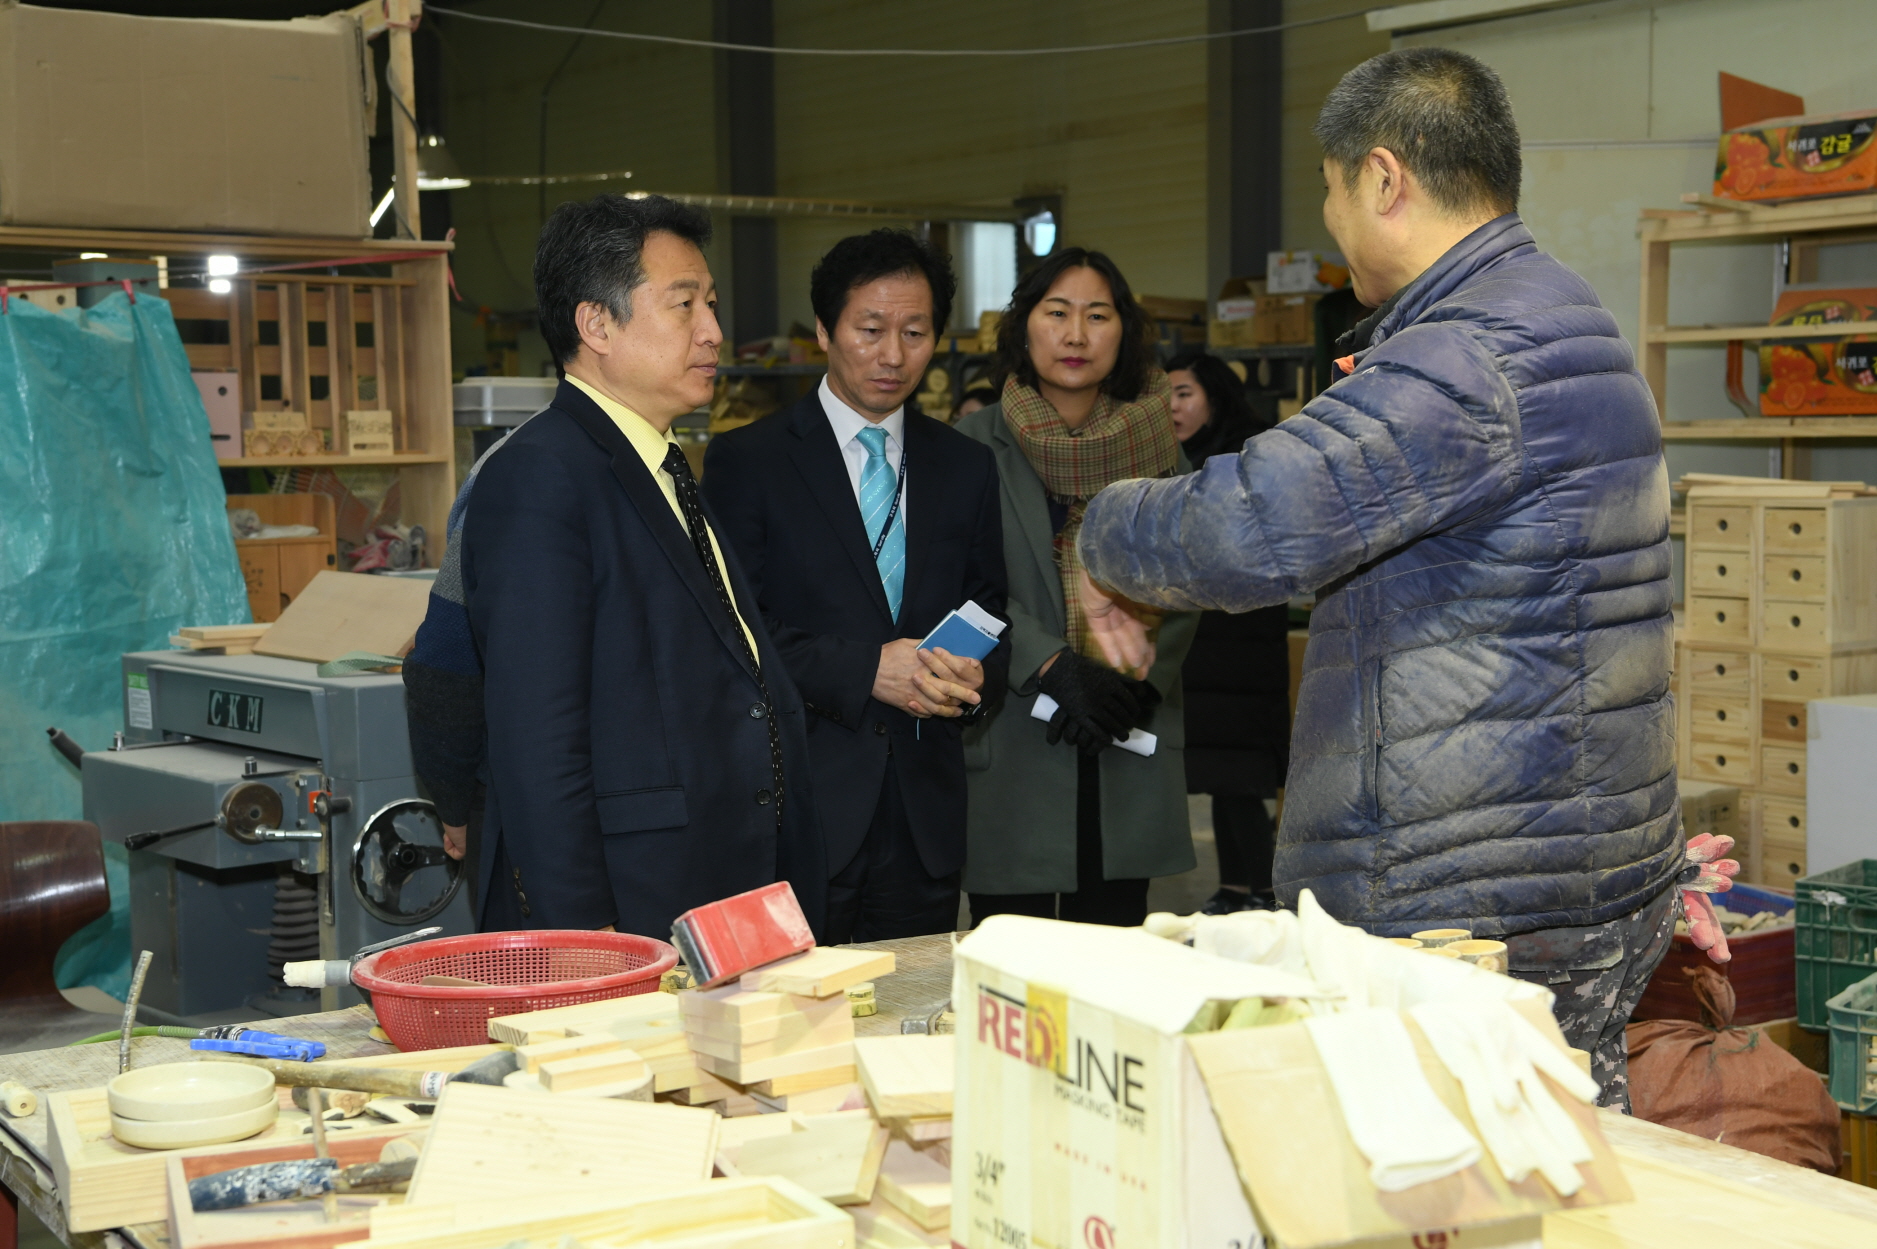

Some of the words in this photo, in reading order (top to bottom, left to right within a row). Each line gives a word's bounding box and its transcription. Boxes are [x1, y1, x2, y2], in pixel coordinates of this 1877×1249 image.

[1820, 133, 1853, 156] 감귤
[211, 691, 261, 732] CKM
[1055, 1036, 1145, 1113] LINE
